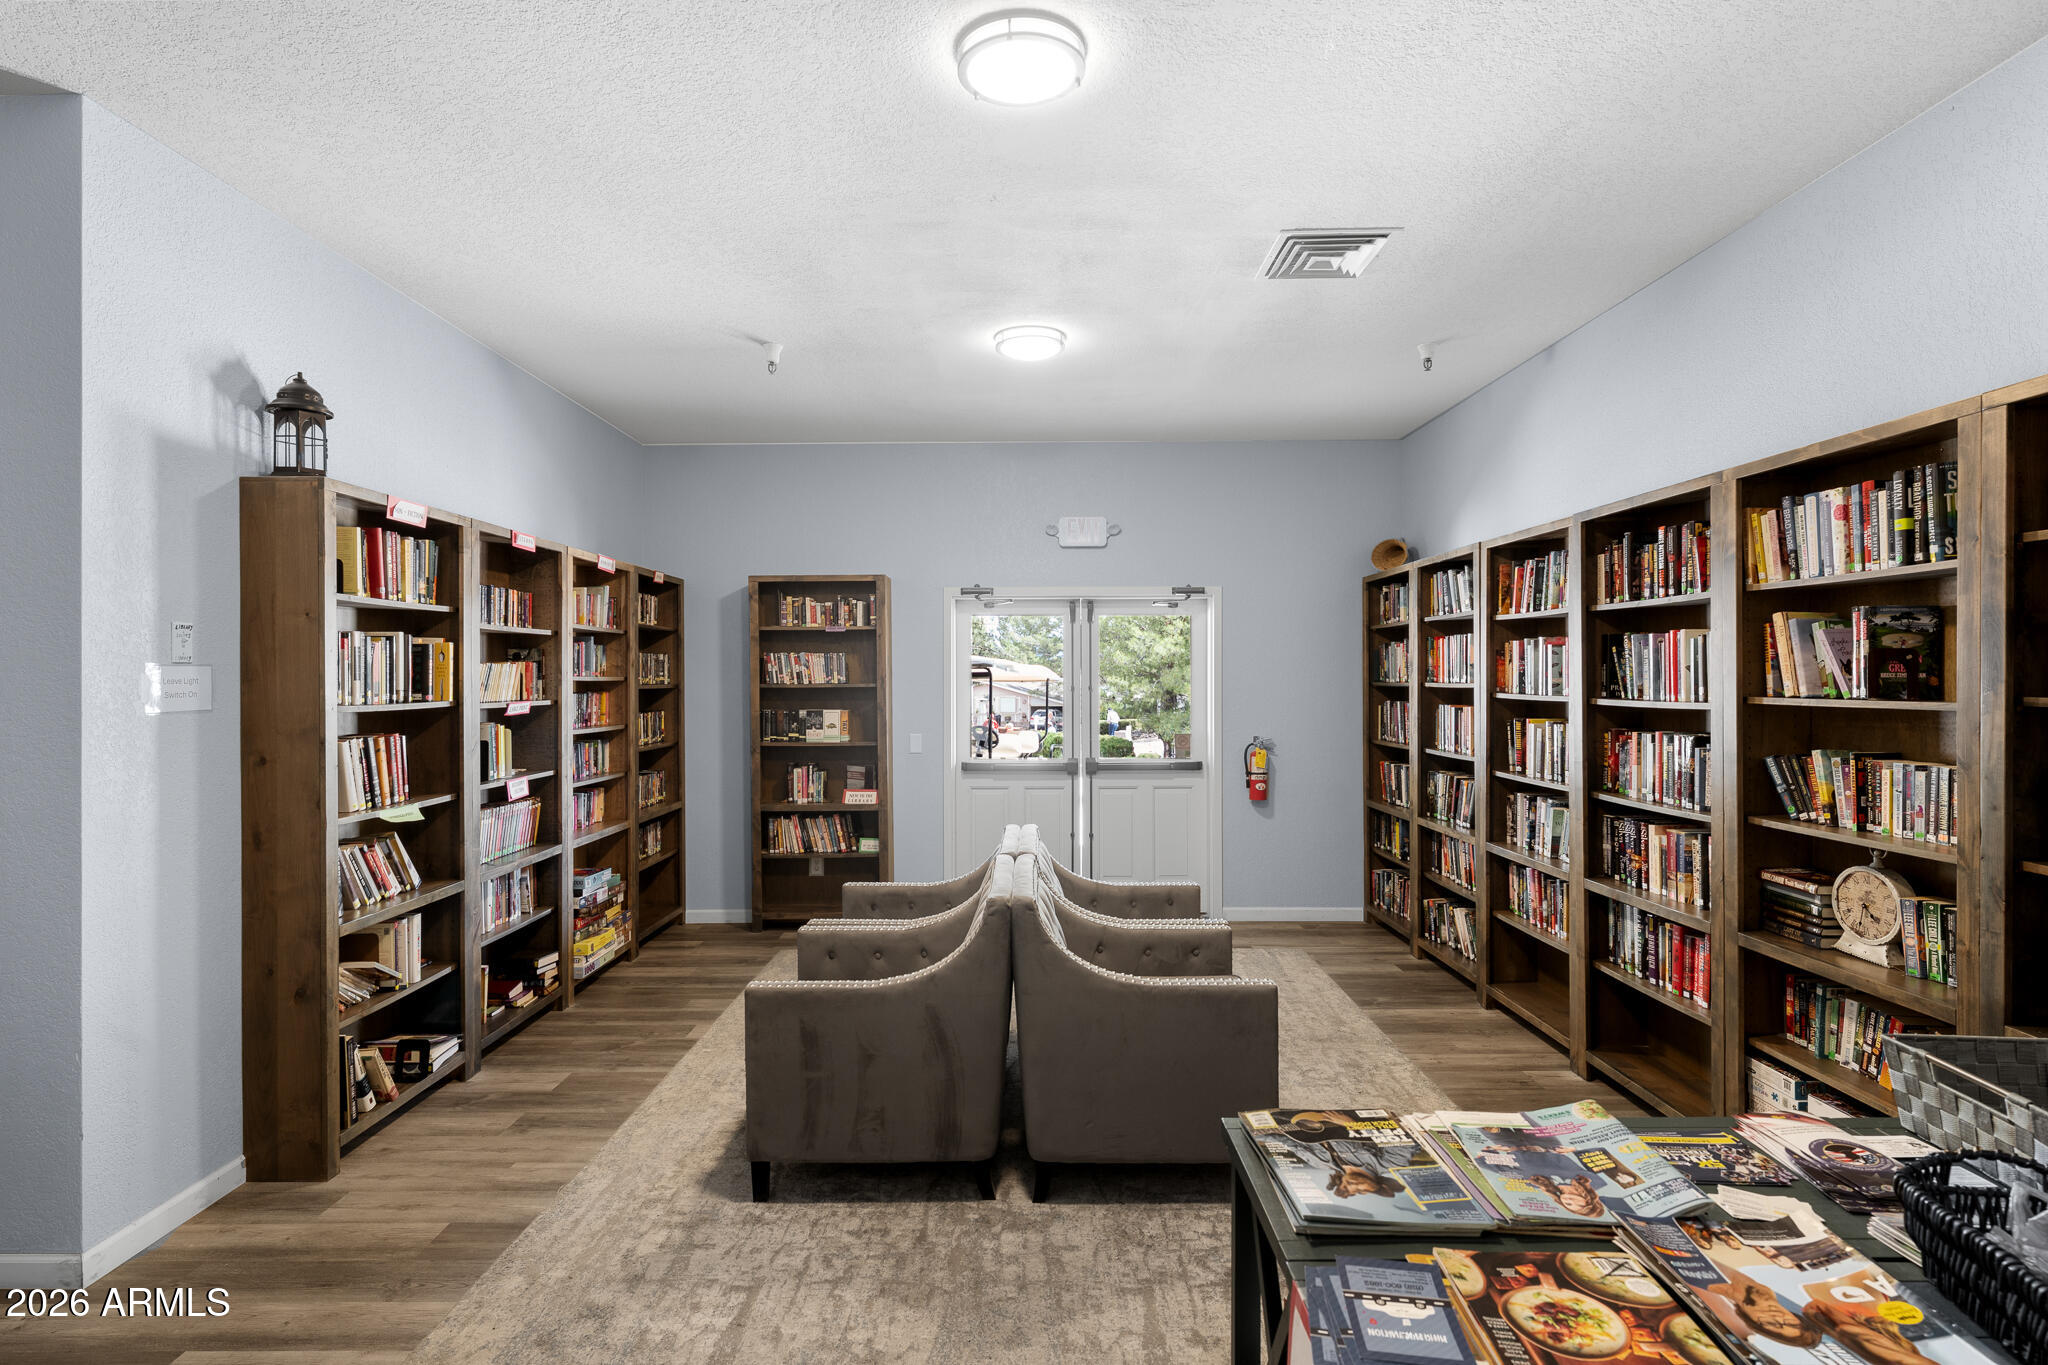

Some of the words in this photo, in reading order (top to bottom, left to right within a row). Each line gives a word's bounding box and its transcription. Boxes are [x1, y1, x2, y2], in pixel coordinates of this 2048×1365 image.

[1893, 480, 1902, 510] LOYALTY
[183, 678, 199, 686] Light
[1928, 918, 1936, 927] LEE
[1929, 928, 1937, 942] CHILD
[1348, 1128, 1405, 1137] PETTY
[1371, 1135, 1412, 1143] TOM
